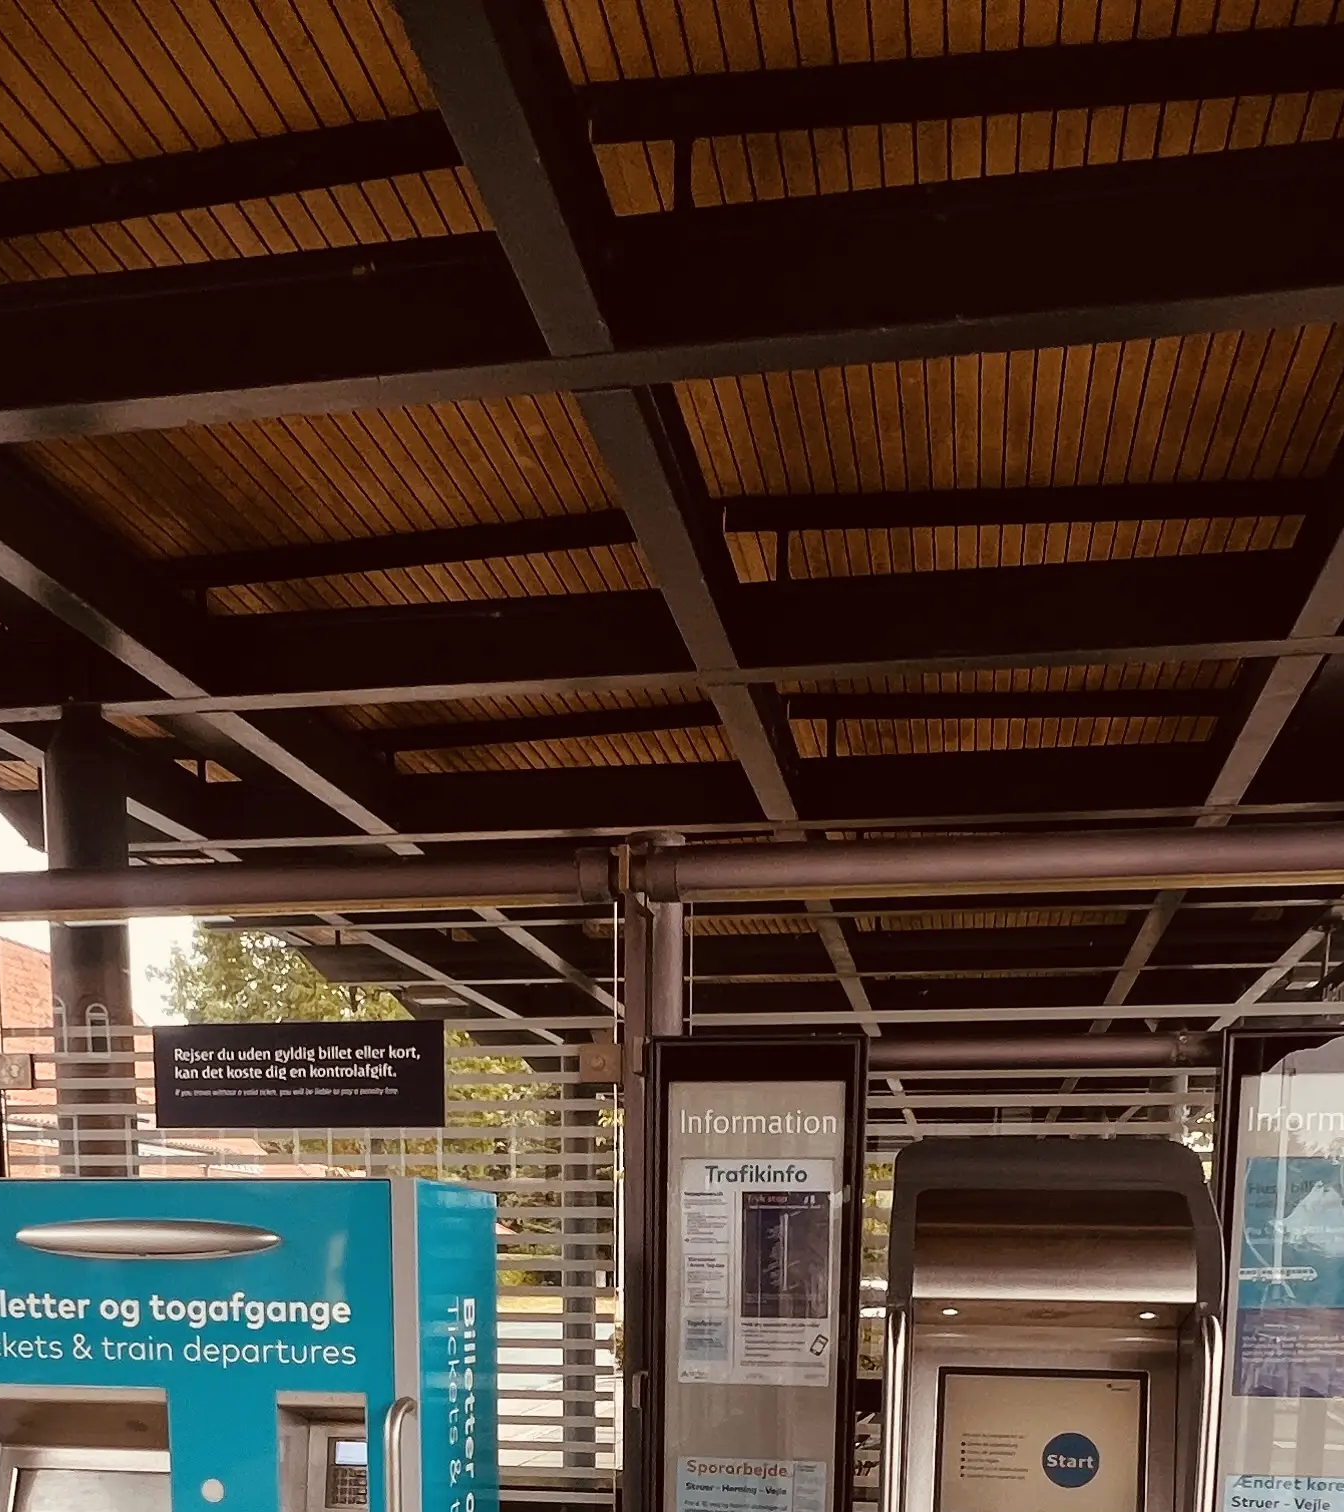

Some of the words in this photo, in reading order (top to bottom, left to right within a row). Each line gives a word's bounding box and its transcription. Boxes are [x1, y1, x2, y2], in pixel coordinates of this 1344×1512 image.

[174, 1048, 214, 1064] Rejser
[217, 1047, 234, 1061] du
[238, 1047, 271, 1061] uden
[274, 1046, 315, 1063] gyldig
[318, 1046, 352, 1060] billet
[355, 1045, 386, 1060] eller
[389, 1045, 421, 1061] kort,
[174, 1066, 199, 1079] kan
[202, 1066, 224, 1079] det
[227, 1065, 262, 1079] koste
[265, 1065, 287, 1081] dig
[289, 1068, 306, 1078] en
[310, 1063, 397, 1080] kontrolafgift.
[680, 1109, 837, 1134] Information
[705, 1164, 807, 1184] Trafikinfo
[99, 1297, 140, 1327] og
[149, 1292, 351, 1331] togafgange
[72, 1333, 93, 1360] &
[101, 1334, 172, 1361] train
[183, 1335, 357, 1368] departures
[447, 1296, 460, 1445] Tickets
[463, 1298, 476, 1479] Billetter
[687, 1459, 788, 1479] Sporarbejde
[1046, 1454, 1094, 1469] Start
[685, 1482, 714, 1492] Struer
[1233, 1474, 1302, 1490] Ændret
[1231, 1496, 1280, 1509] Struer
[1294, 1498, 1331, 1512] Vejle
